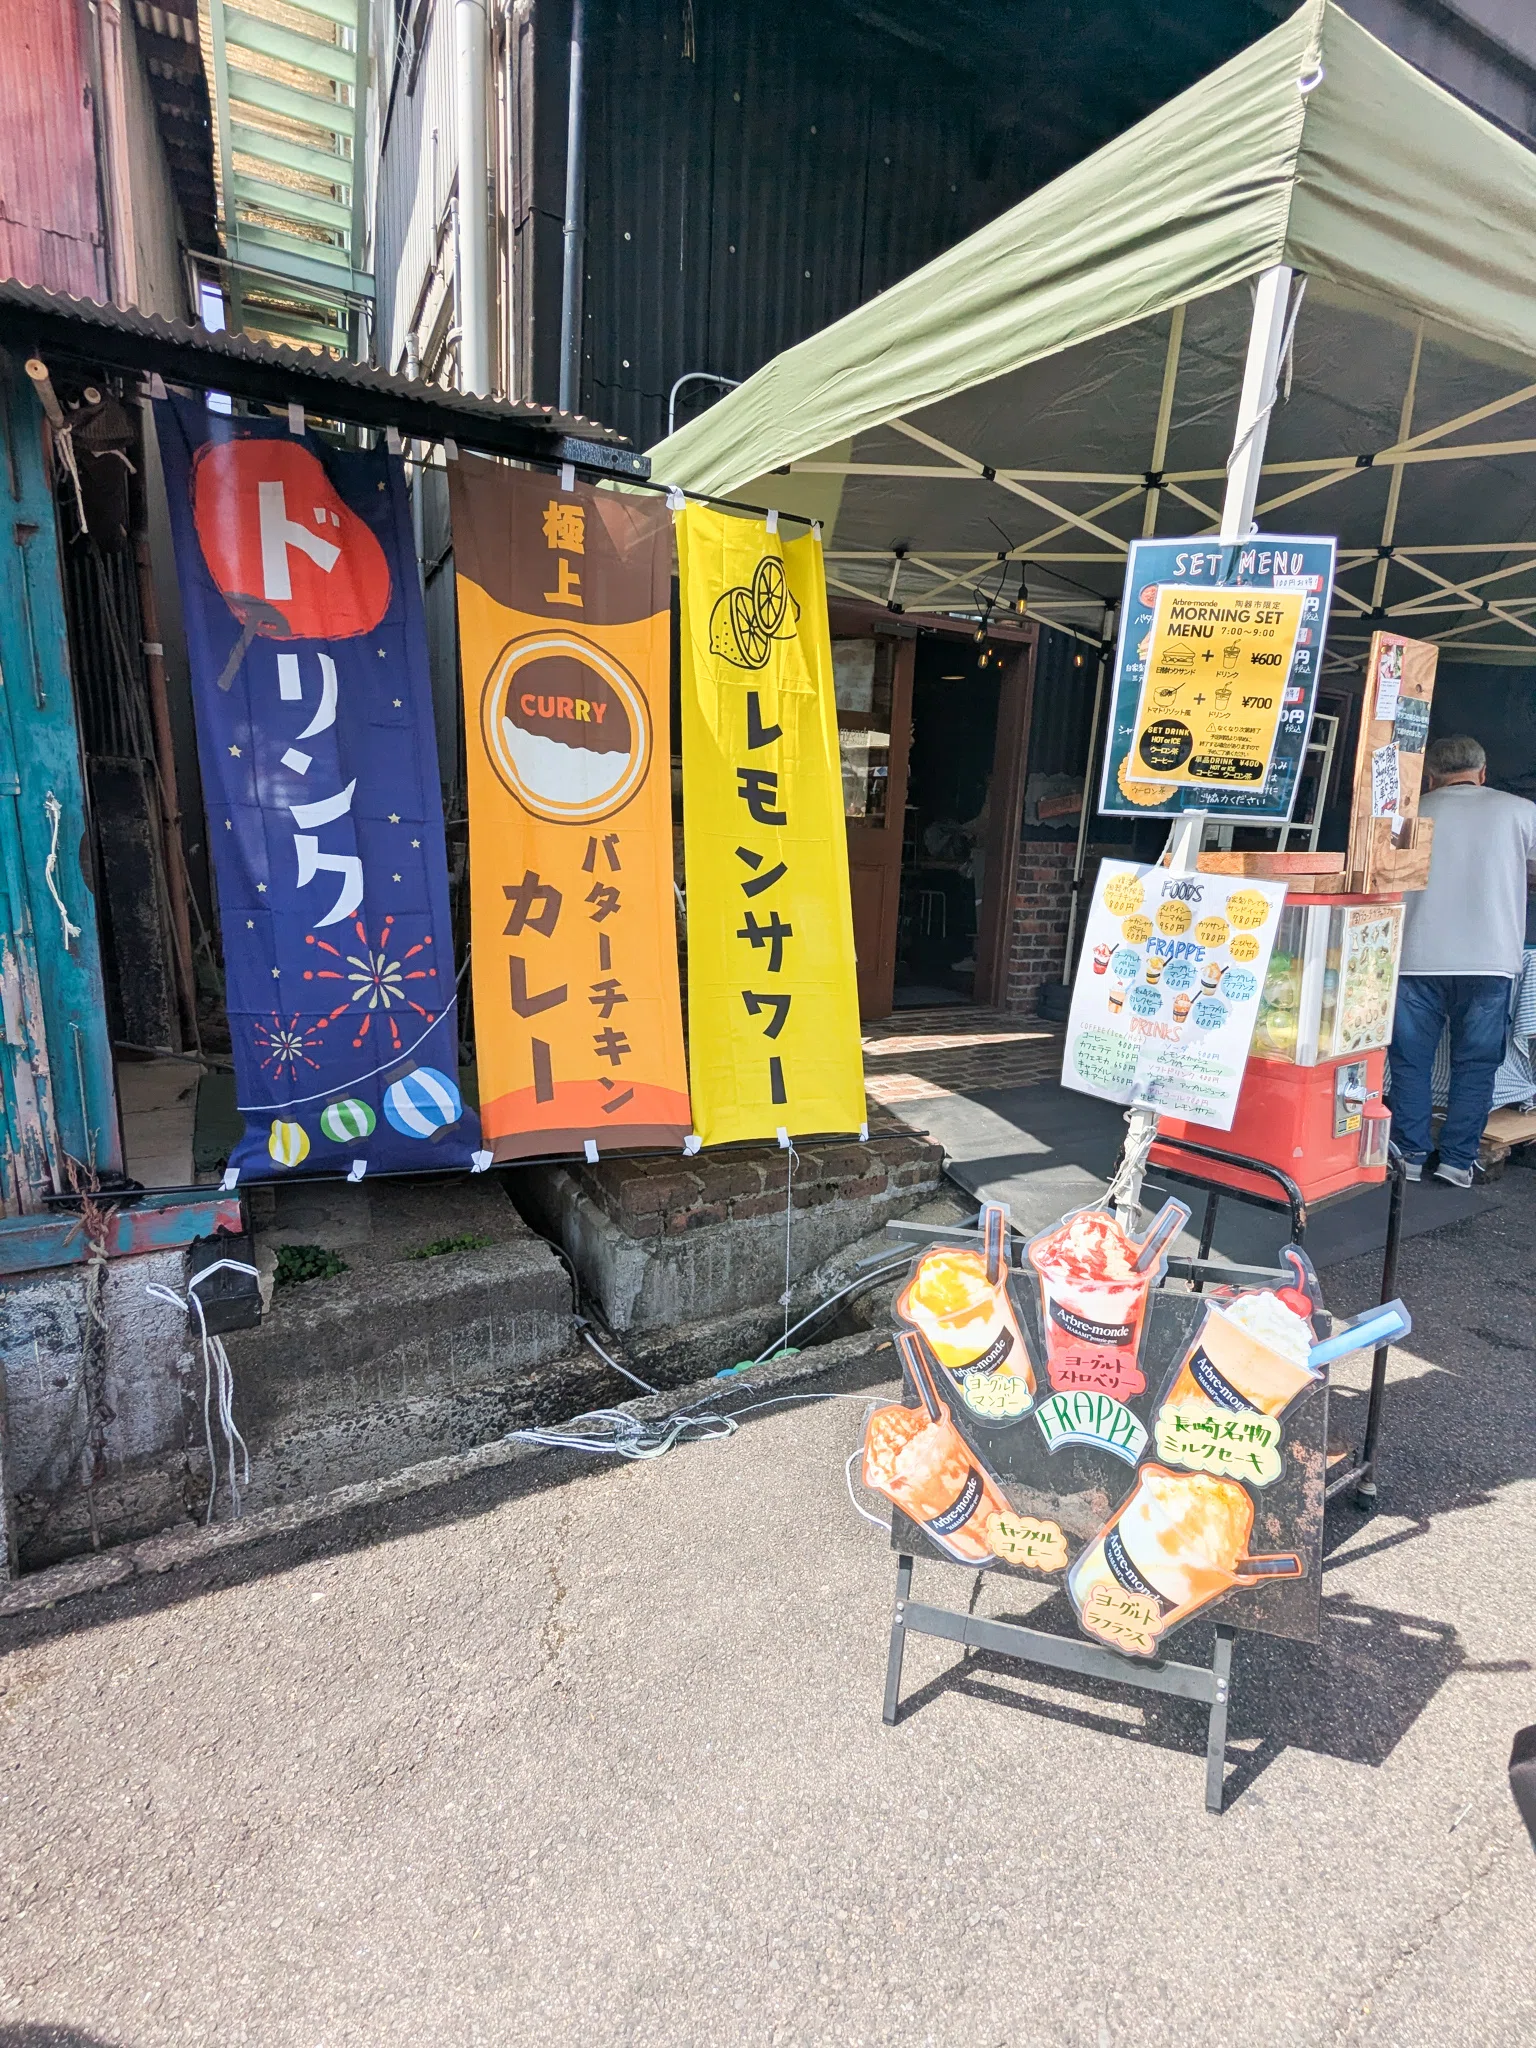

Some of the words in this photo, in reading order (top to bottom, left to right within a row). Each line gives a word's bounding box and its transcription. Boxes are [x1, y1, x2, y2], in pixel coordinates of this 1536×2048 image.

[542, 500, 586, 609] 極上
[1172, 552, 1223, 576] SET
[1238, 549, 1304, 575] MENU
[1173, 598, 1218, 607] Arbre-monde
[1235, 600, 1281, 610] 陶器市限定
[1170, 606, 1250, 623] MORNING
[1254, 610, 1284, 625] SET
[1167, 623, 1214, 638] MENU
[1251, 652, 1282, 667] ¥600
[1216, 670, 1239, 679] ドリンク
[258, 479, 364, 928] ドリンク
[520, 693, 607, 724] CURRY
[1242, 696, 1272, 710] ¥700
[1208, 711, 1231, 719] ドリンク
[1147, 726, 1163, 734] SET
[1165, 727, 1190, 736] DRINK
[1150, 747, 1179, 755] ウーロン茶
[1151, 757, 1174, 765] コーヒー
[1239, 759, 1260, 768] ¥400
[1223, 772, 1253, 780] ウーロン茶
[1132, 786, 1166, 795] ウーロン茶
[1160, 880, 1205, 902] FOODS
[735, 692, 794, 1106] レモンサワー
[1109, 900, 1134, 912] 800円
[1159, 922, 1185, 933] 950円
[1232, 915, 1262, 927] 780円
[1200, 932, 1226, 943] 780円
[1146, 937, 1206, 962] FRAPPE
[581, 833, 635, 1114] バターチキン
[1114, 967, 1137, 977] 600円
[502, 870, 570, 1104] カレー
[1166, 978, 1190, 988] 600円
[1226, 990, 1250, 1000] 600円
[1199, 1010, 1222, 1019] コーヒー
[1195, 1017, 1221, 1029] 600円
[1082, 1031, 1108, 1042] コーヒー
[1080, 1040, 1112, 1054] カフェラテ
[1116, 1050, 1139, 1062] 550円
[1078, 1051, 1110, 1065] カフェモカ
[1114, 1062, 1136, 1073] 650円
[1078, 1060, 1111, 1075] キャラメル
[1112, 1075, 1133, 1086] 650円
[1057, 1309, 1130, 1337] Arbre-monde
[952, 1339, 1006, 1378] Arbre-monde
[1065, 1354, 1127, 1373] ヨーグルト
[970, 1377, 1020, 1394] ヨーグルト
[1058, 1370, 1137, 1388] ストロベリー
[1197, 1358, 1254, 1413] Arbre-mond
[973, 1394, 1019, 1407] マンゴー
[1037, 1391, 1142, 1454] FRAPPE
[1170, 1415, 1271, 1447] 長崎名物
[1164, 1435, 1264, 1475] ミルクセーキ
[932, 1477, 977, 1529] Arbre-monde
[997, 1522, 1057, 1543] キャラメル
[1001, 1542, 1052, 1557] コーヒー
[1096, 1594, 1155, 1625] ヨーグルト
[1088, 1612, 1146, 1646] ラフランス
